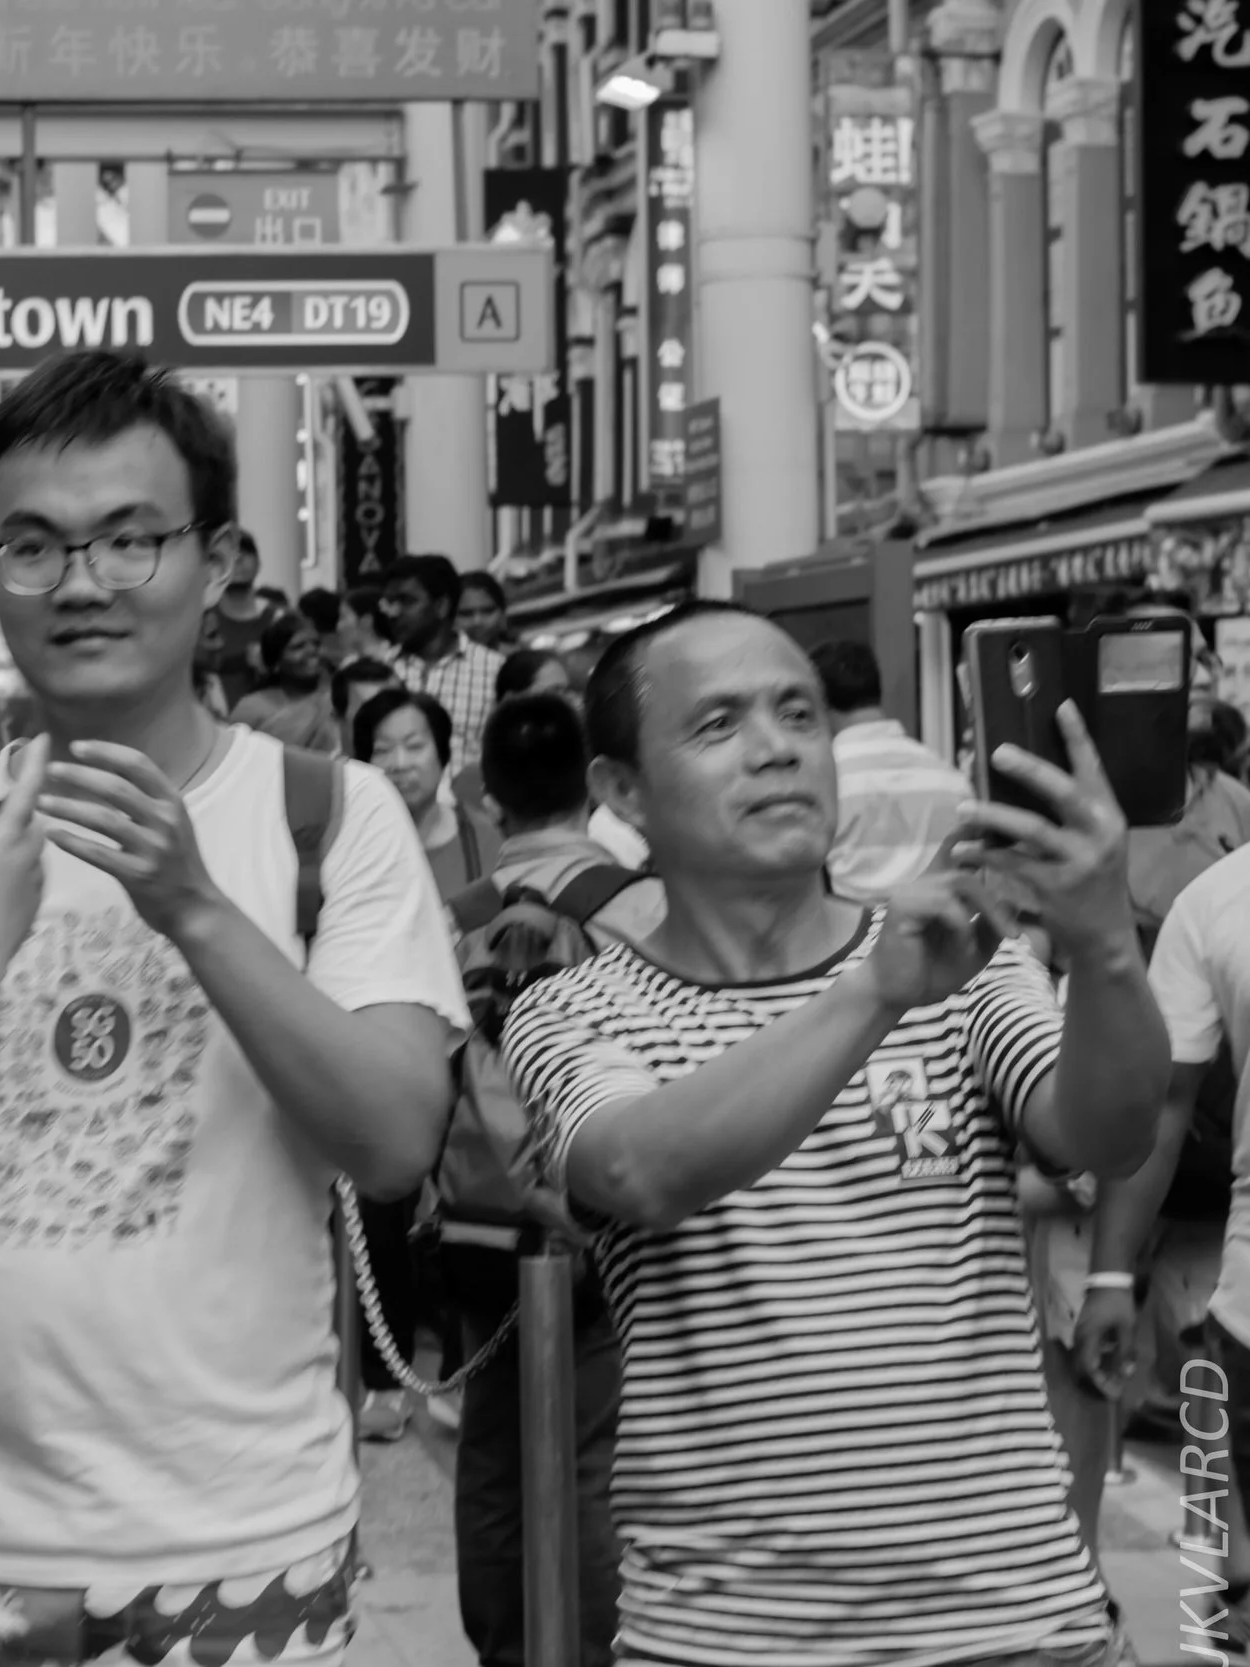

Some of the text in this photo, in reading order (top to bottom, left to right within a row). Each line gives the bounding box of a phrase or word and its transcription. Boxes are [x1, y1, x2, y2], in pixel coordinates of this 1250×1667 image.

[263, 187, 312, 211] EXIT
[204, 297, 274, 331] NE4
[304, 296, 392, 329] DT19
[477, 295, 503, 329] A
